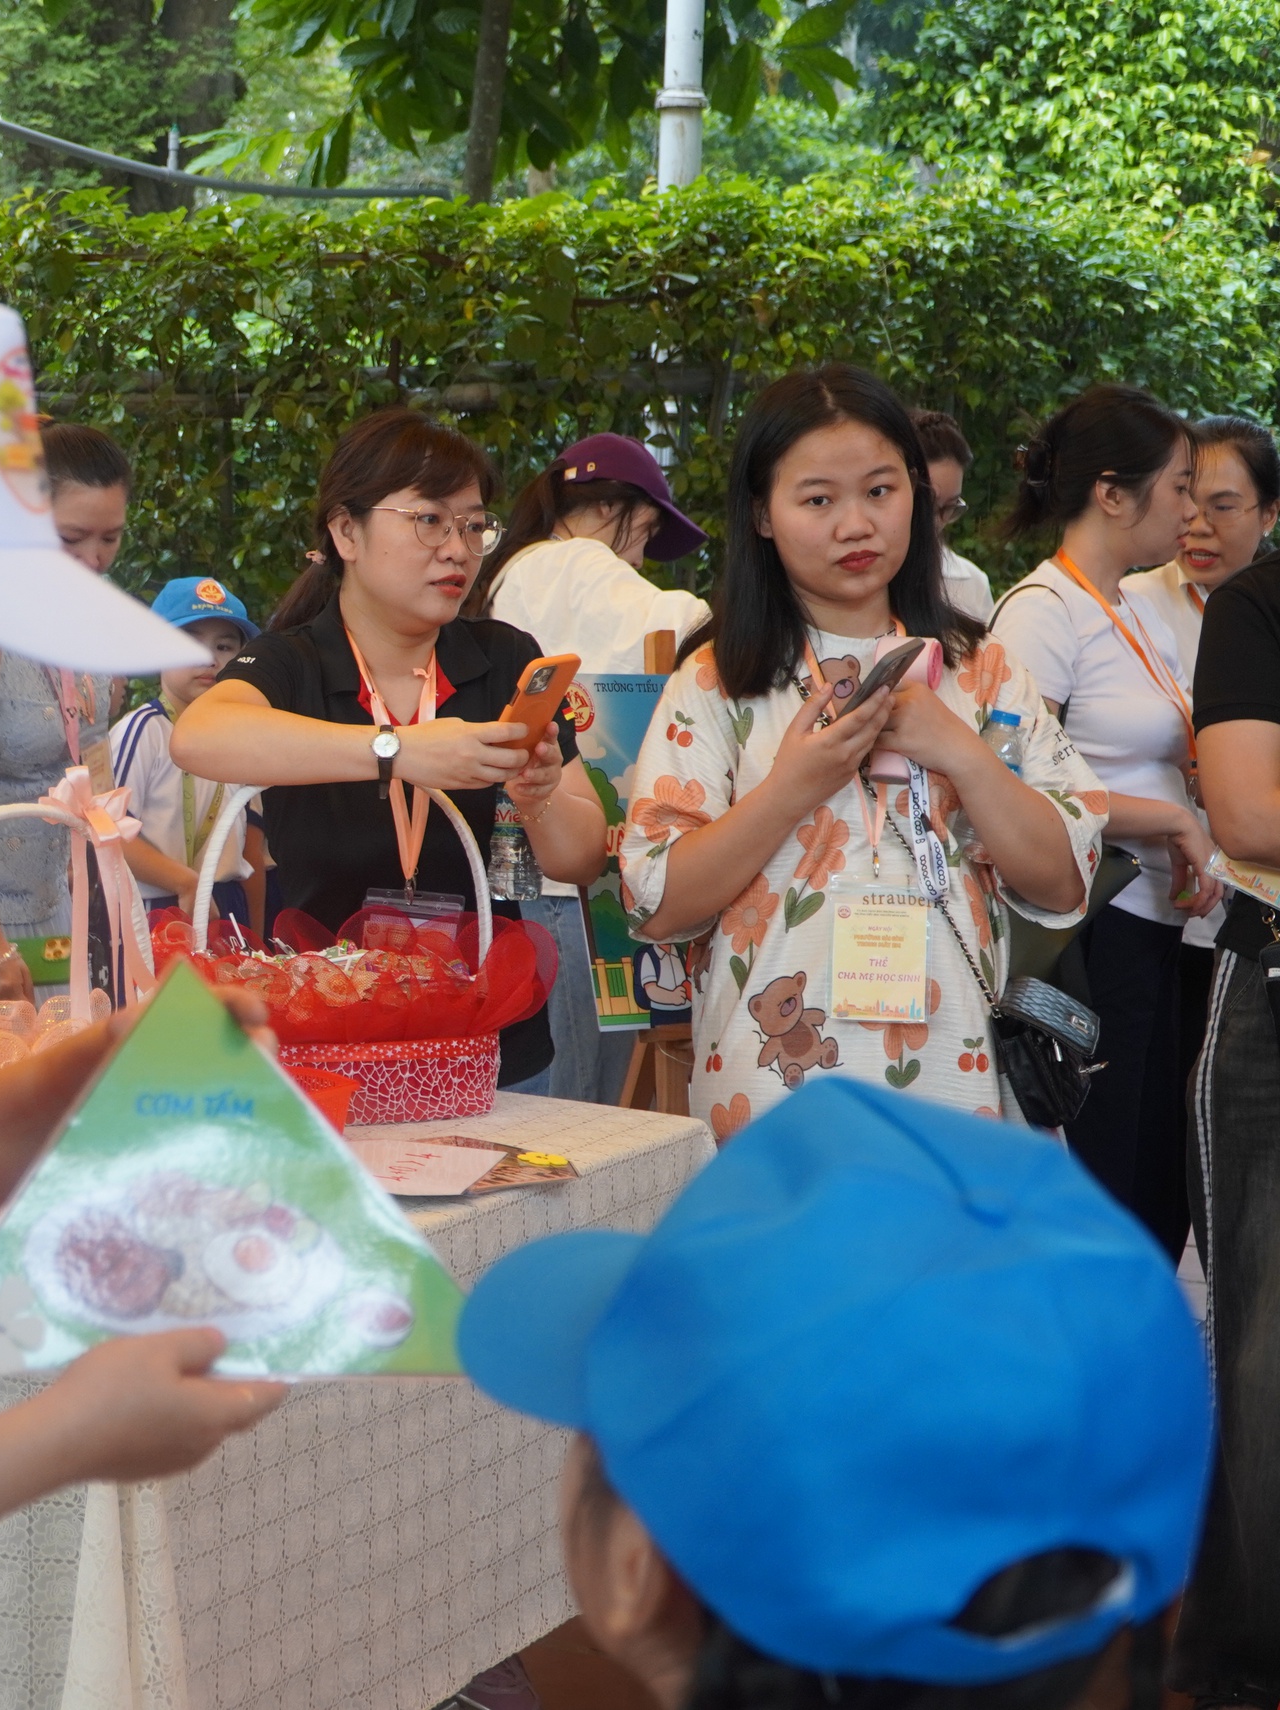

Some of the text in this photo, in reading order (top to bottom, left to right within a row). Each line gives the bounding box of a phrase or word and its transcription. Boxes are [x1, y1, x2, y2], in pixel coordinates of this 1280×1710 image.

[593, 679, 634, 693] TRƯỜNG
[635, 678, 659, 693] TIỂU
[869, 957, 889, 968] THẺ
[837, 971, 922, 984] CHA MẸ HỌC SINH
[135, 1091, 194, 1117] CƠM
